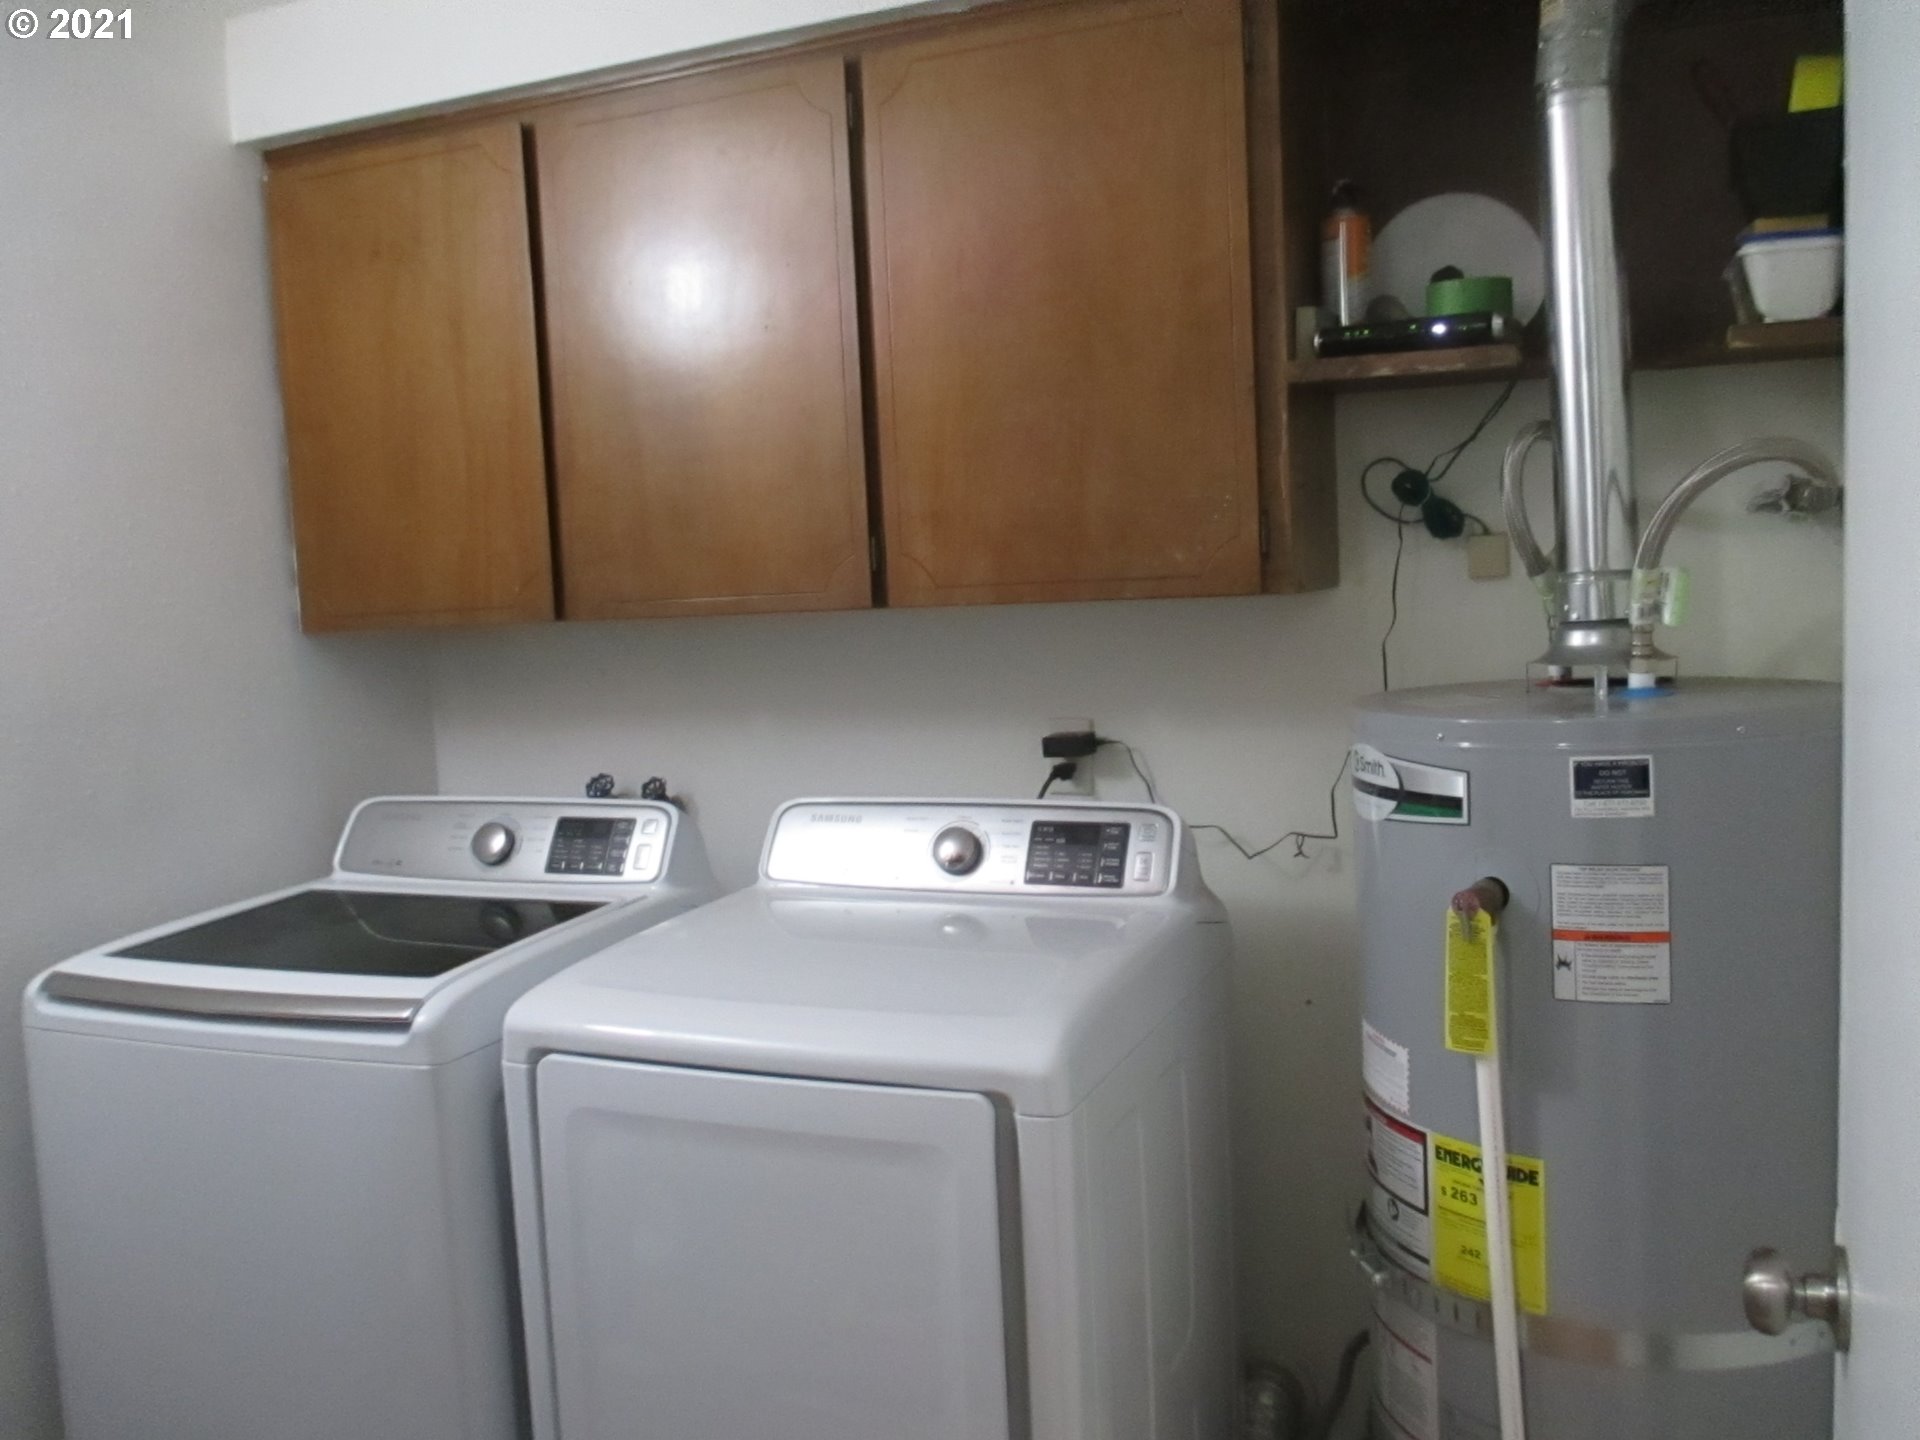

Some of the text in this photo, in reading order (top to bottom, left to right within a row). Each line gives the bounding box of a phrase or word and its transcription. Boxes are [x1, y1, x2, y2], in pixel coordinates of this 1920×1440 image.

[809, 812, 863, 824] SAMSUNG
[1451, 1186, 1478, 1207] 263
[1460, 1244, 1481, 1260] 242
